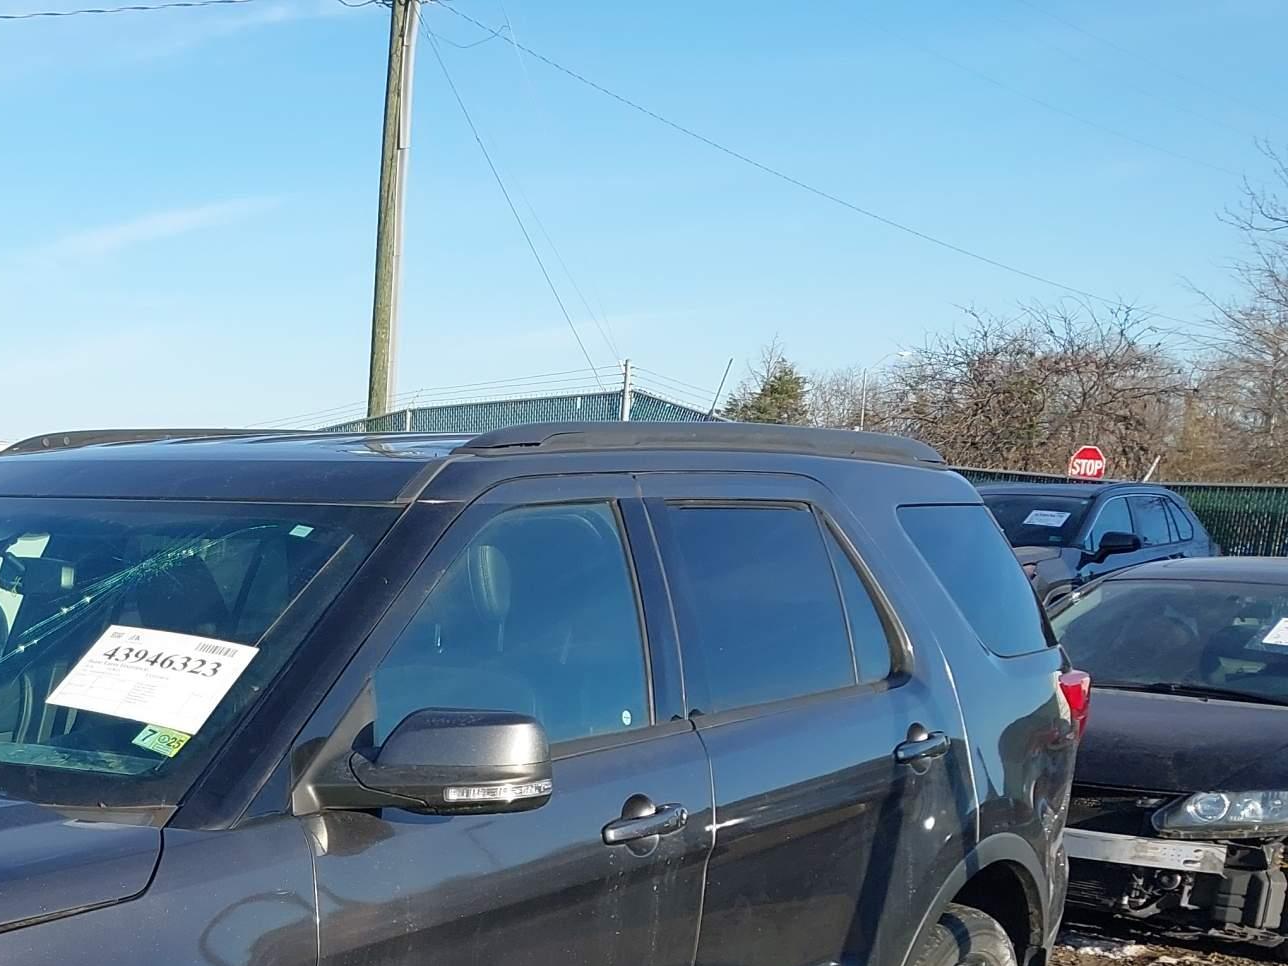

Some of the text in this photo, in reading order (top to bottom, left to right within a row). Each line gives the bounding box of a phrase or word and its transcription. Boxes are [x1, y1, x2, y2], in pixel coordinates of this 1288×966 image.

[1072, 459, 1103, 476] STOP
[103, 645, 223, 678] 43946323
[142, 728, 185, 750] 7 25
